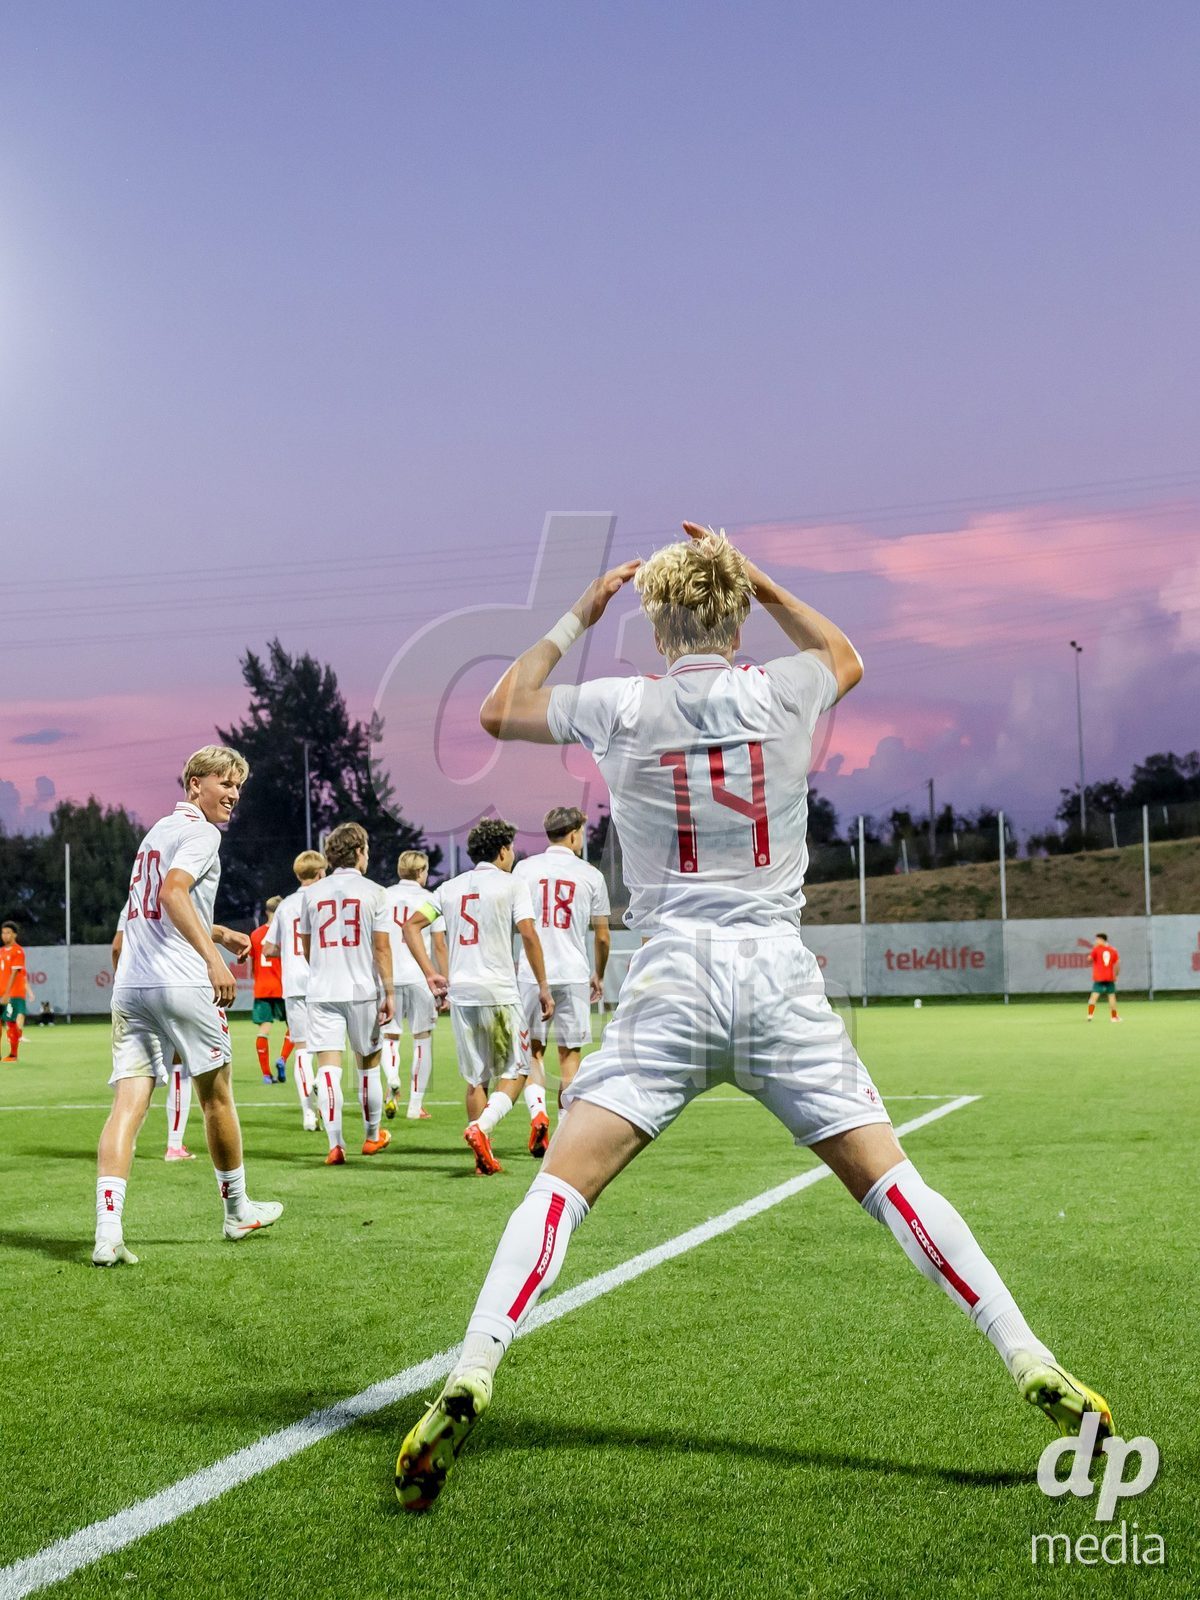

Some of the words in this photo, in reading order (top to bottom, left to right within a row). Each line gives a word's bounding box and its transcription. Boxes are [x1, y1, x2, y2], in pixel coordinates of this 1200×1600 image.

[660, 741, 771, 873] 14
[128, 850, 162, 920] 20
[539, 879, 577, 929] 18
[317, 898, 362, 948] 23
[459, 893, 480, 945] 5
[884, 947, 986, 973] tek4life
